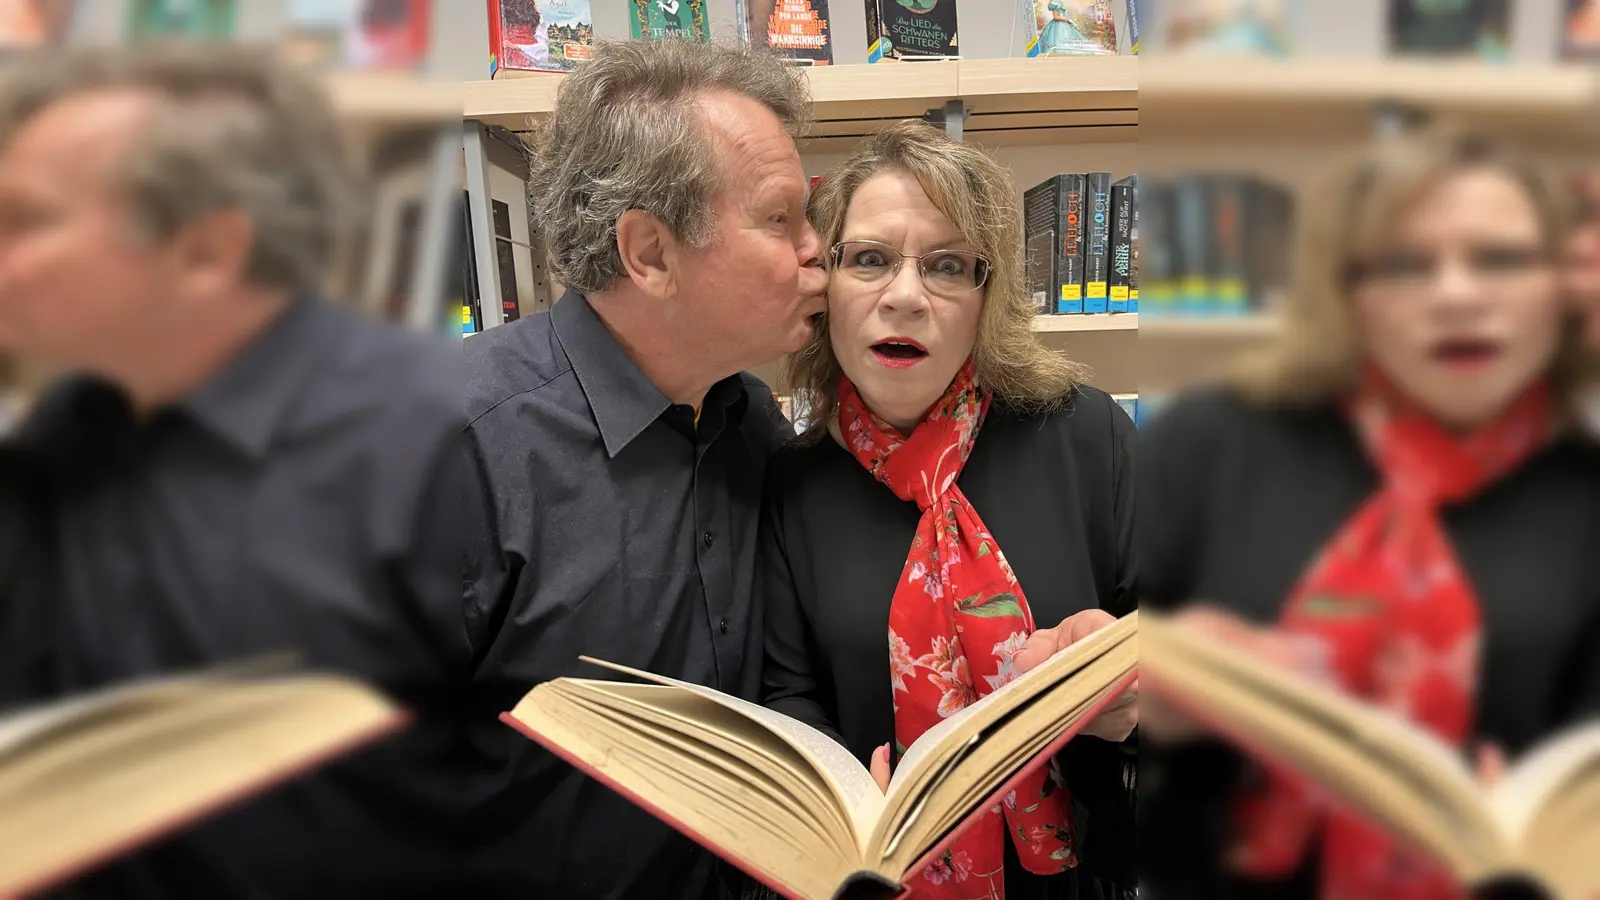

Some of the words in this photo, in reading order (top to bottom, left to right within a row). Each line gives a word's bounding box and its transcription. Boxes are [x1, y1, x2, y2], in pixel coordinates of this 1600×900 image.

[790, 24, 803, 34] DIE
[910, 17, 932, 29] LIED
[771, 33, 826, 46] WAHNSINNIGE
[892, 24, 948, 41] SCHWANEN
[901, 34, 941, 49] RITTERS
[1068, 193, 1078, 238] FLOCH
[1095, 192, 1105, 237] FLOCH
[1067, 241, 1077, 257] LE
[1094, 241, 1104, 256] LE
[1114, 244, 1123, 274] ANNE
[1120, 242, 1130, 276] PERRY
